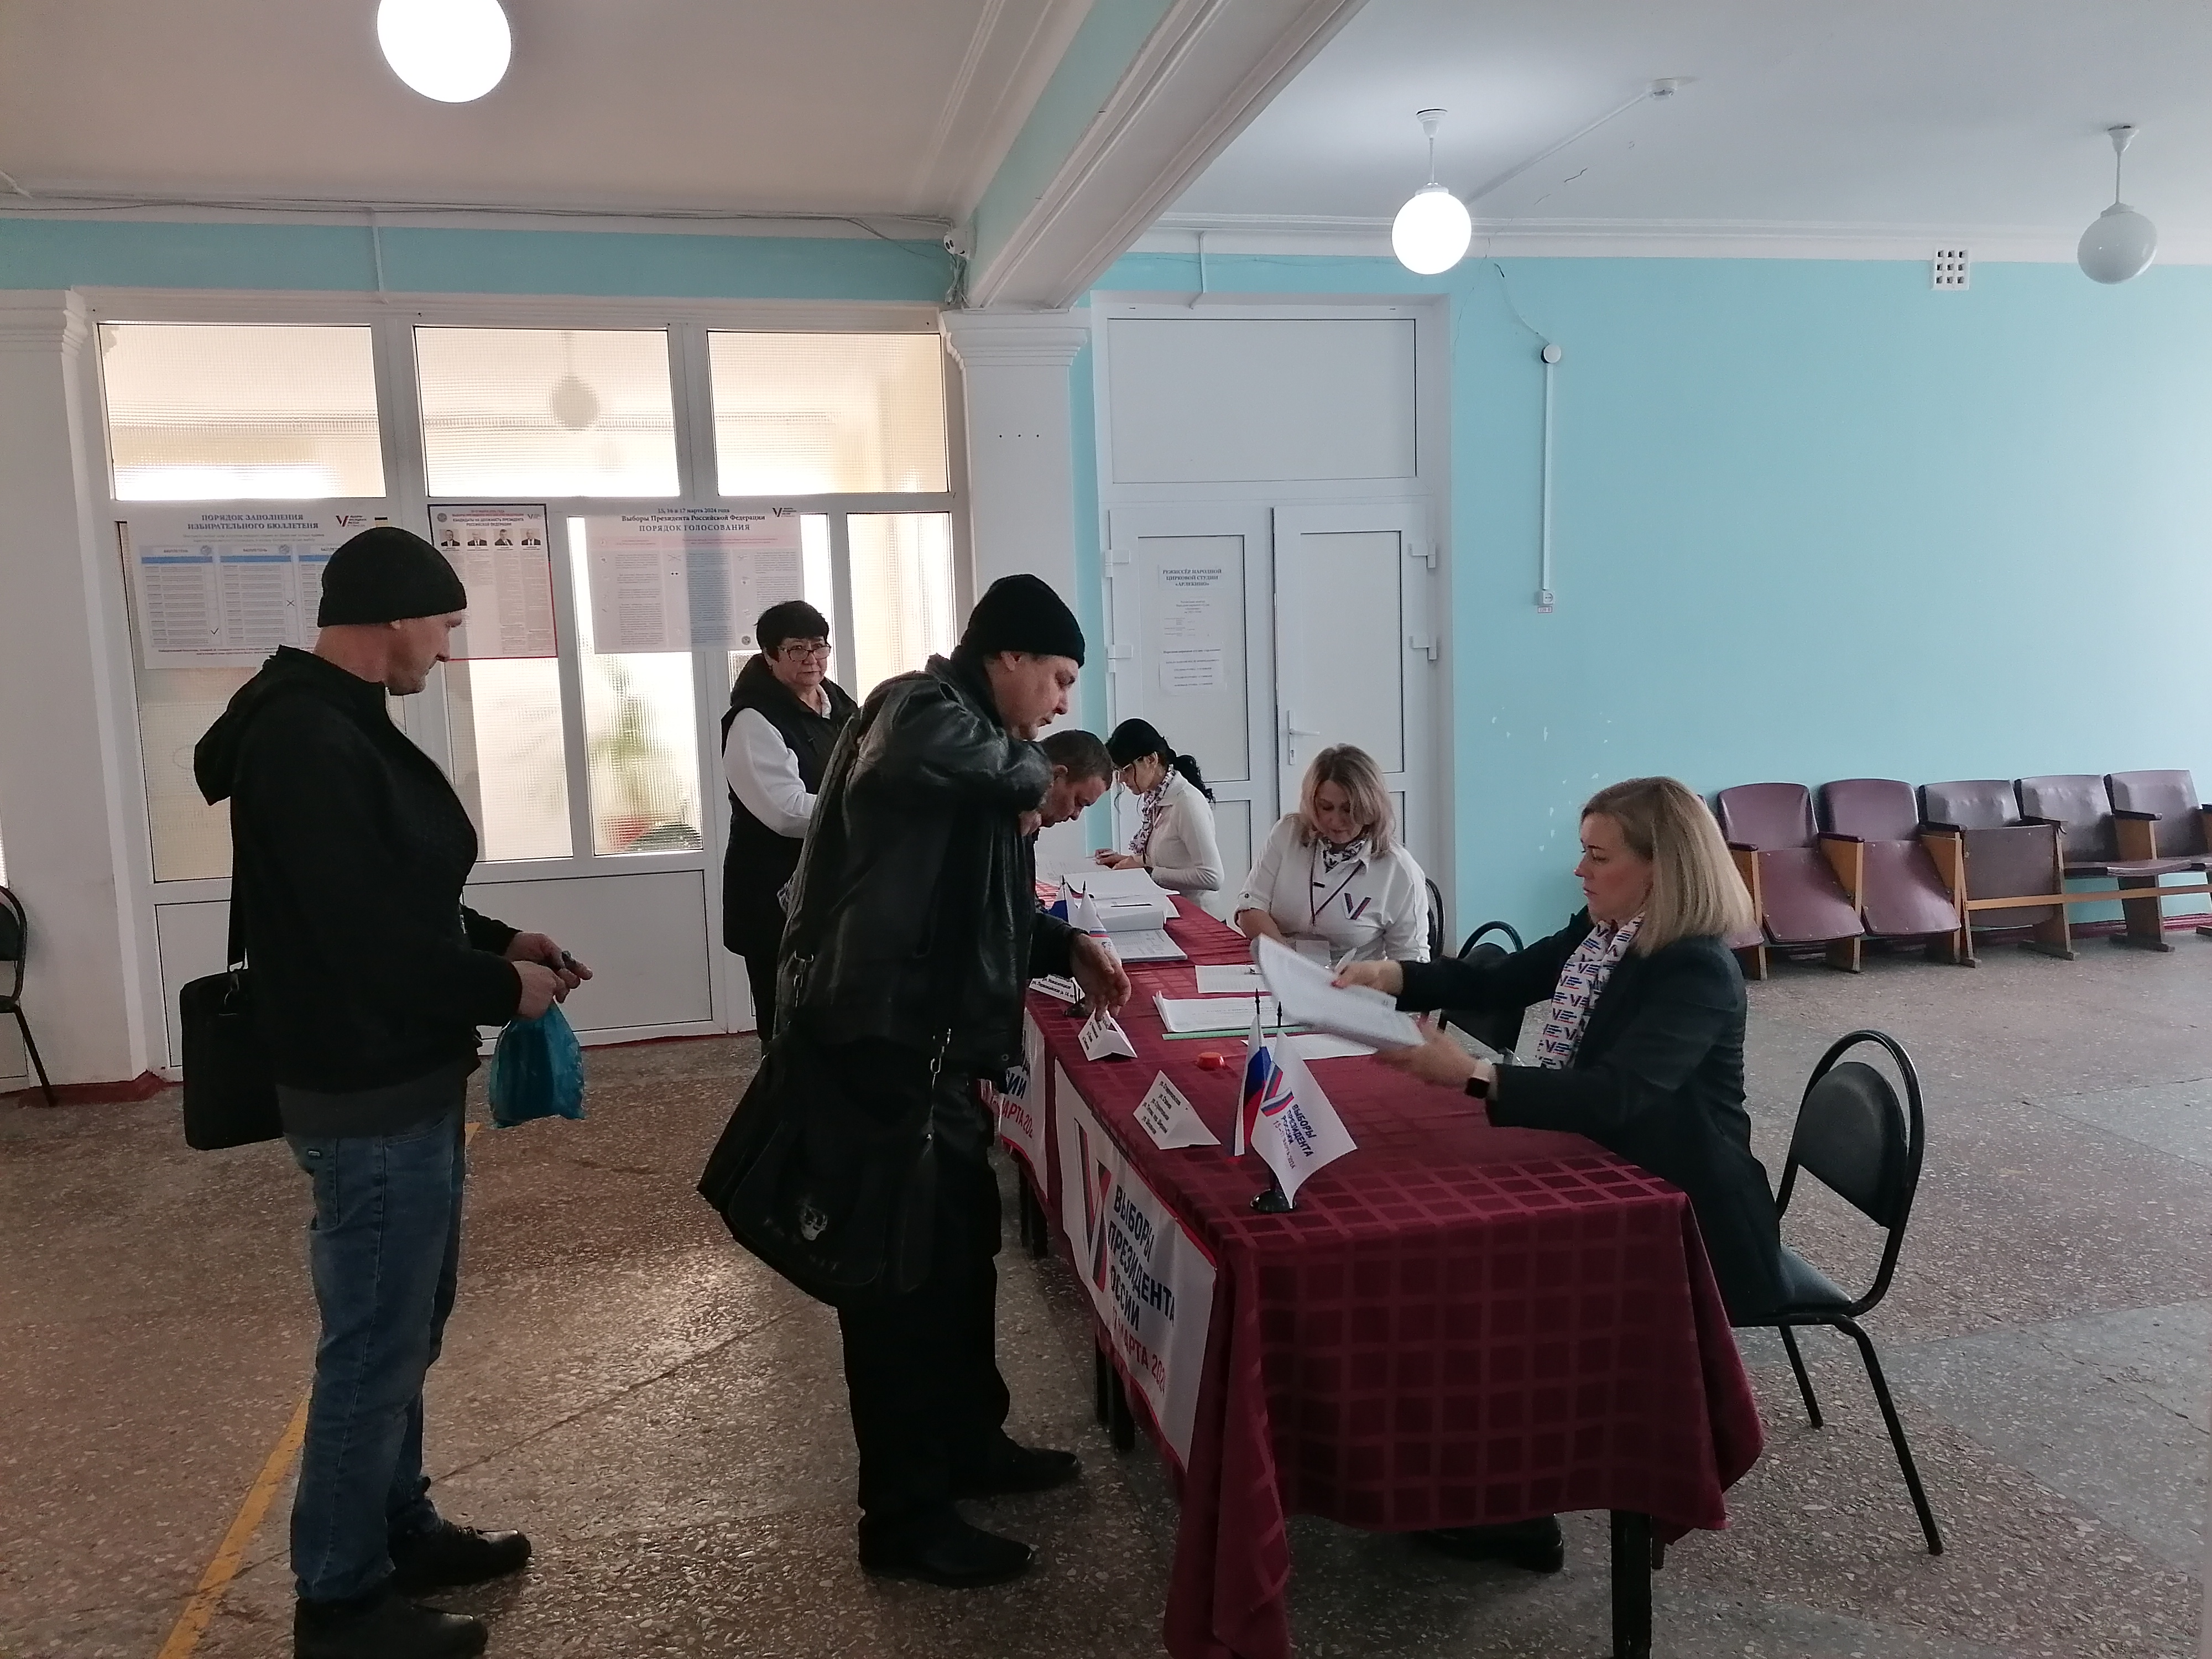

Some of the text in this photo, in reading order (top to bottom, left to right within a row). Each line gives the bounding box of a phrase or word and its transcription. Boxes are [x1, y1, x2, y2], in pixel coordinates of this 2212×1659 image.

[1281, 1115, 1294, 1145] РОССИИ
[1286, 1109, 1314, 1157] ПРЕЗИДЕНТА
[1292, 1104, 1317, 1138] ВЫБОРЫ
[1113, 1184, 1155, 1263] ВЫБОРЫ
[1108, 1220, 1176, 1327] ПРЕЗИДЕНТА
[1110, 1264, 1141, 1331] ОССИИ
